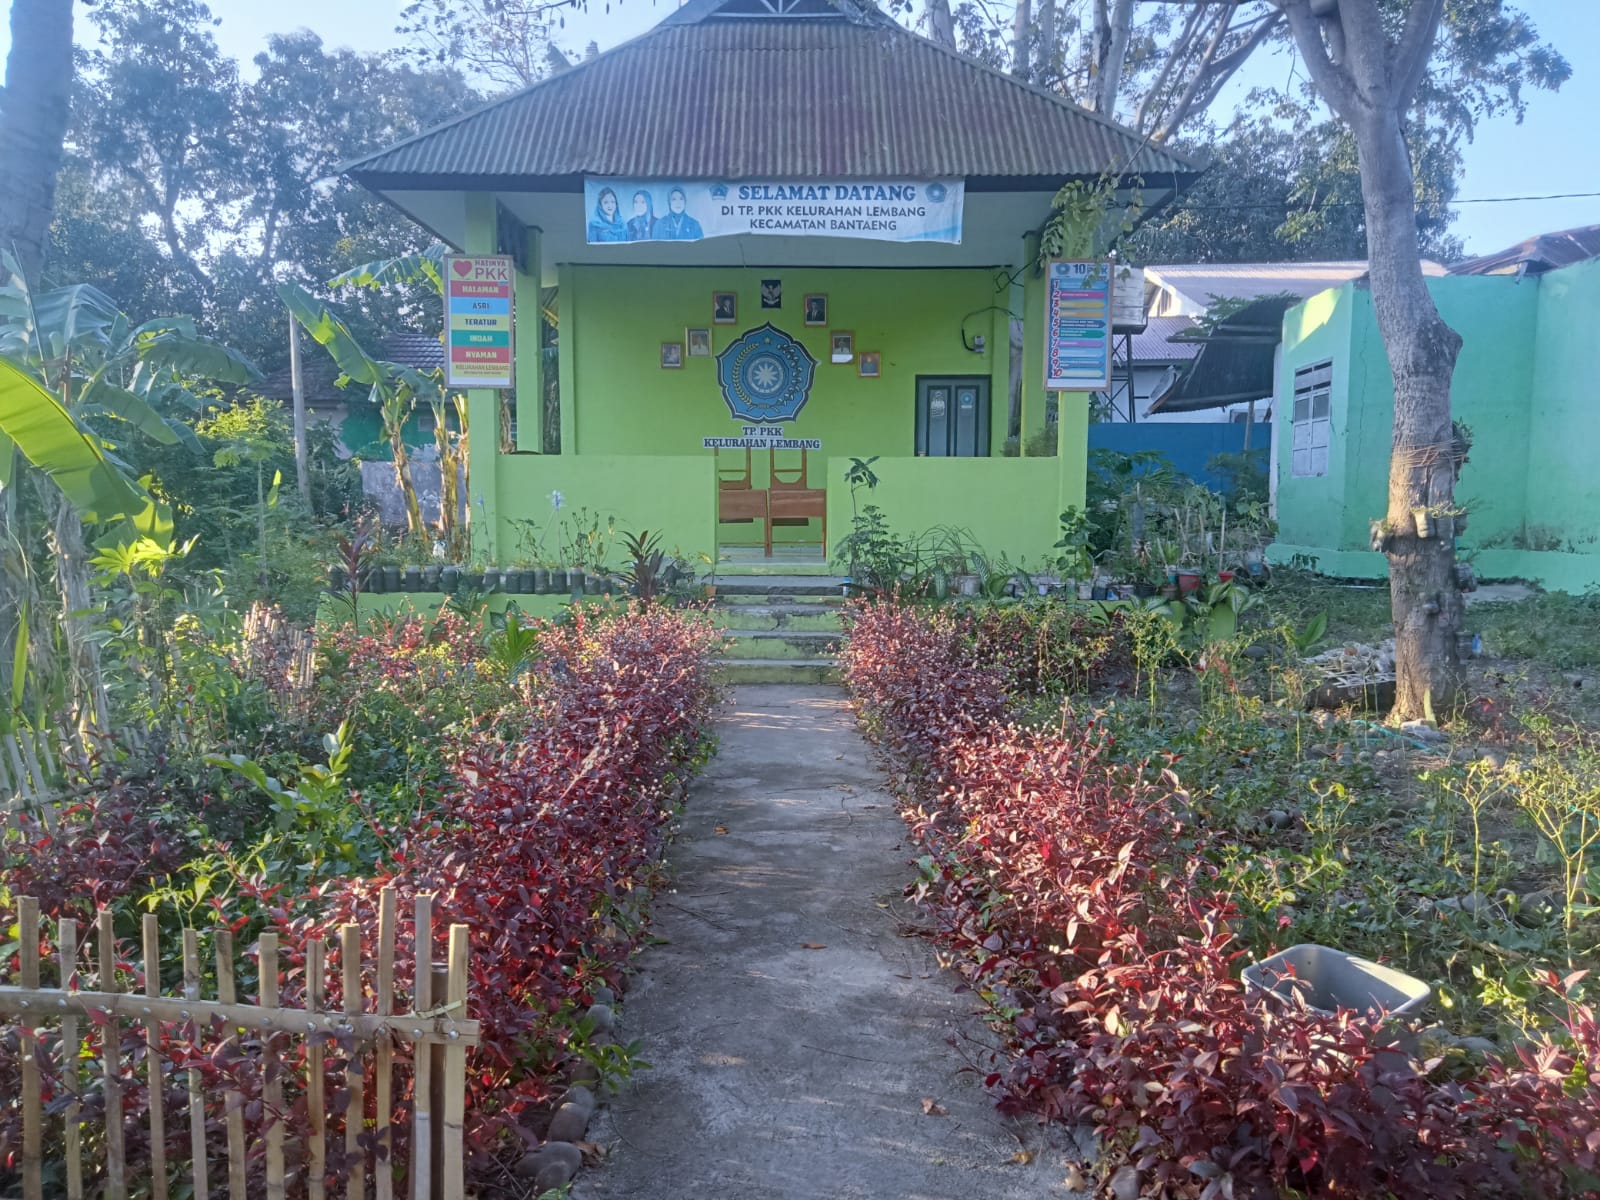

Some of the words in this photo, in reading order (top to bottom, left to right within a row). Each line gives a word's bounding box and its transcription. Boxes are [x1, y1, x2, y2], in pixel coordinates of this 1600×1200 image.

[738, 185, 830, 201] SELAMAT
[834, 185, 917, 201] DATANG
[721, 205, 734, 216] DI
[758, 206, 783, 217] PKK
[786, 206, 863, 217] KELURAHAN
[866, 206, 926, 218] LEMBANG
[750, 219, 826, 230] KECAMATAN
[830, 219, 897, 231] BANTAENG
[475, 267, 508, 281] PKK
[1072, 263, 1087, 275] 10
[462, 285, 499, 294] HALAMAN
[472, 301, 490, 310] ASRI
[465, 318, 498, 327] TERATUR
[469, 335, 493, 343] INDAH
[465, 351, 498, 359] NYAMAN
[760, 427, 783, 436] PKK
[704, 438, 768, 448] KELURAHAN
[769, 439, 820, 449] LEMBANG
